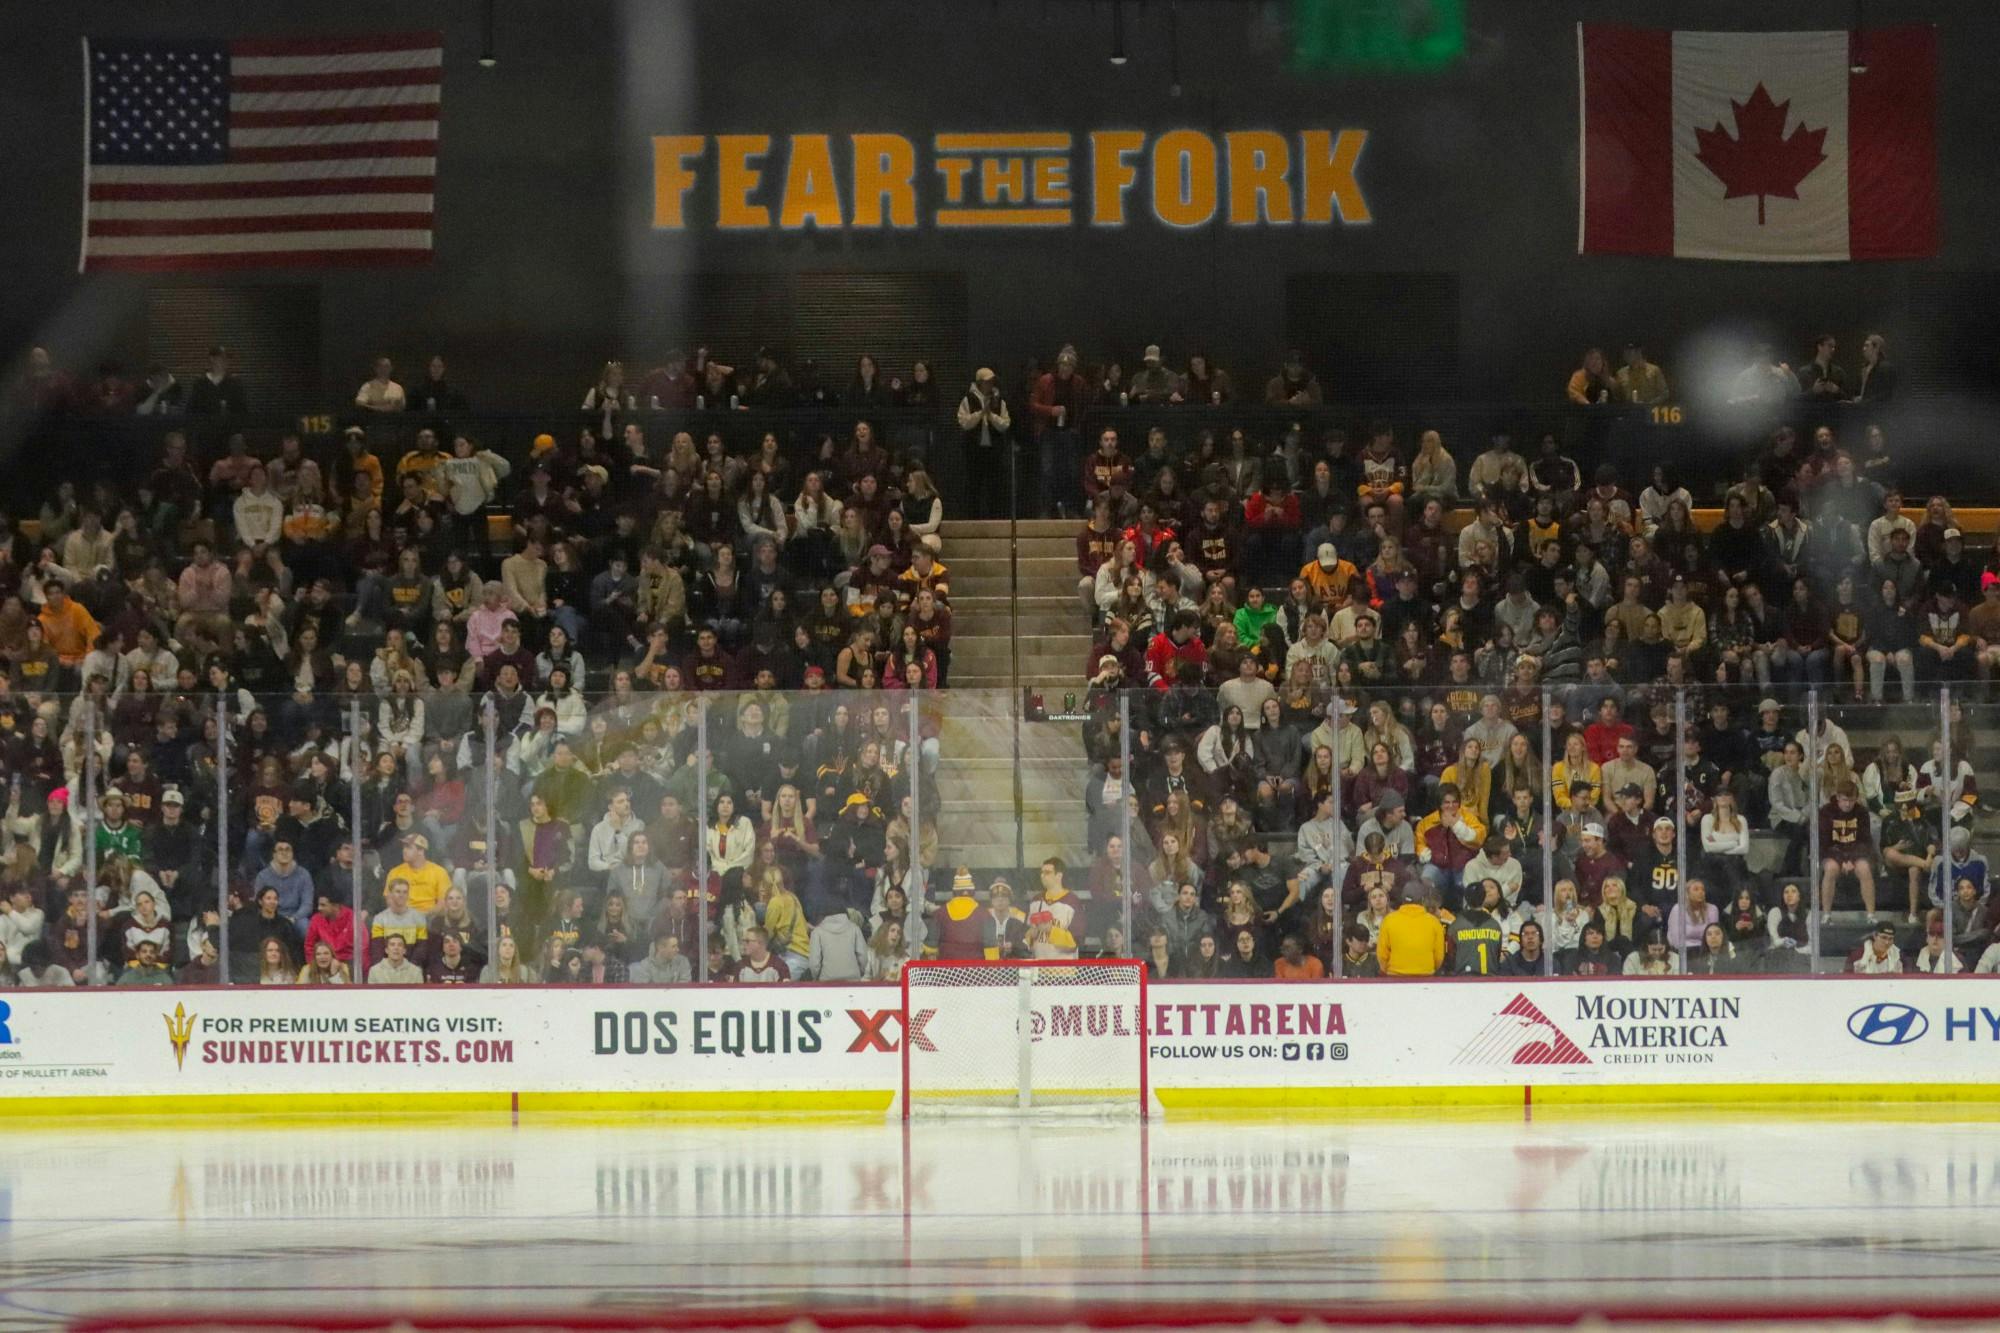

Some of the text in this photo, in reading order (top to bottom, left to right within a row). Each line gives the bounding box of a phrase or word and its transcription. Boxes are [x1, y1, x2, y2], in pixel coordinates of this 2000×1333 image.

[653, 129, 1372, 228] FEAR THE FORK
[300, 415, 331, 433] 115
[1651, 406, 1681, 424] 116
[1651, 867, 1678, 891] 90
[1457, 928, 1502, 942] INNOVATION
[1477, 943, 1488, 975] 1
[202, 1017, 503, 1033] FOR PREMIUM SEATING VISIT:
[594, 1011, 678, 1055] DOS
[202, 1039, 514, 1063] SUNDEVILTICKETS.COM
[1150, 1045, 1277, 1059] FOLLOW US ON:
[1604, 1053, 1715, 1064] CREDIT UNION
[5, 1070, 20, 1079] OF
[23, 1069, 68, 1078] MULLETT
[71, 1068, 108, 1077] ARENA
